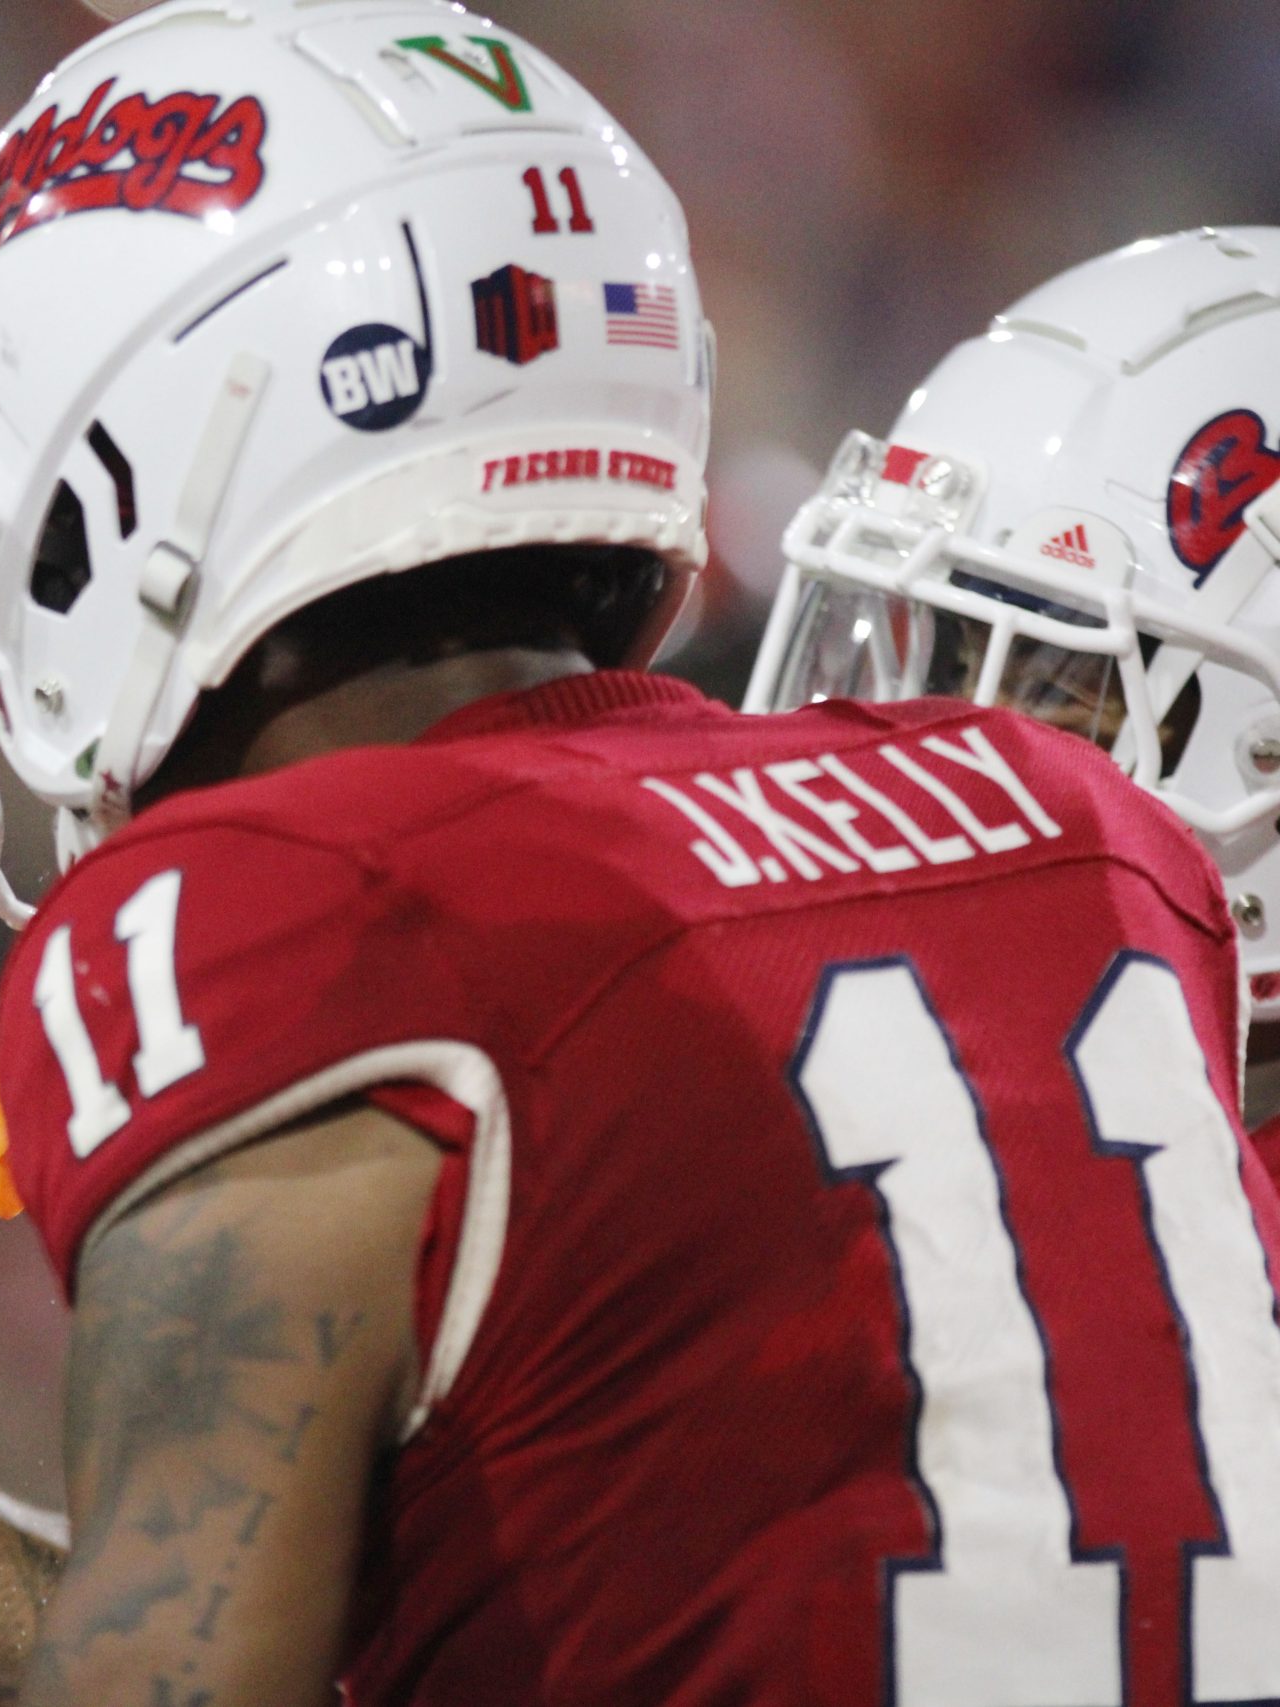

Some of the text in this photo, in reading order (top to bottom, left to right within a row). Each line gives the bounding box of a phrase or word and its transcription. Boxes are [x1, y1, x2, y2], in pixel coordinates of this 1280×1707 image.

[395, 34, 533, 113] V
[523, 166, 595, 234] 11
[322, 340, 420, 416] BW
[642, 725, 1063, 888] J.KELLY
[32, 868, 206, 1160] 11
[786, 948, 1280, 1707] 11
